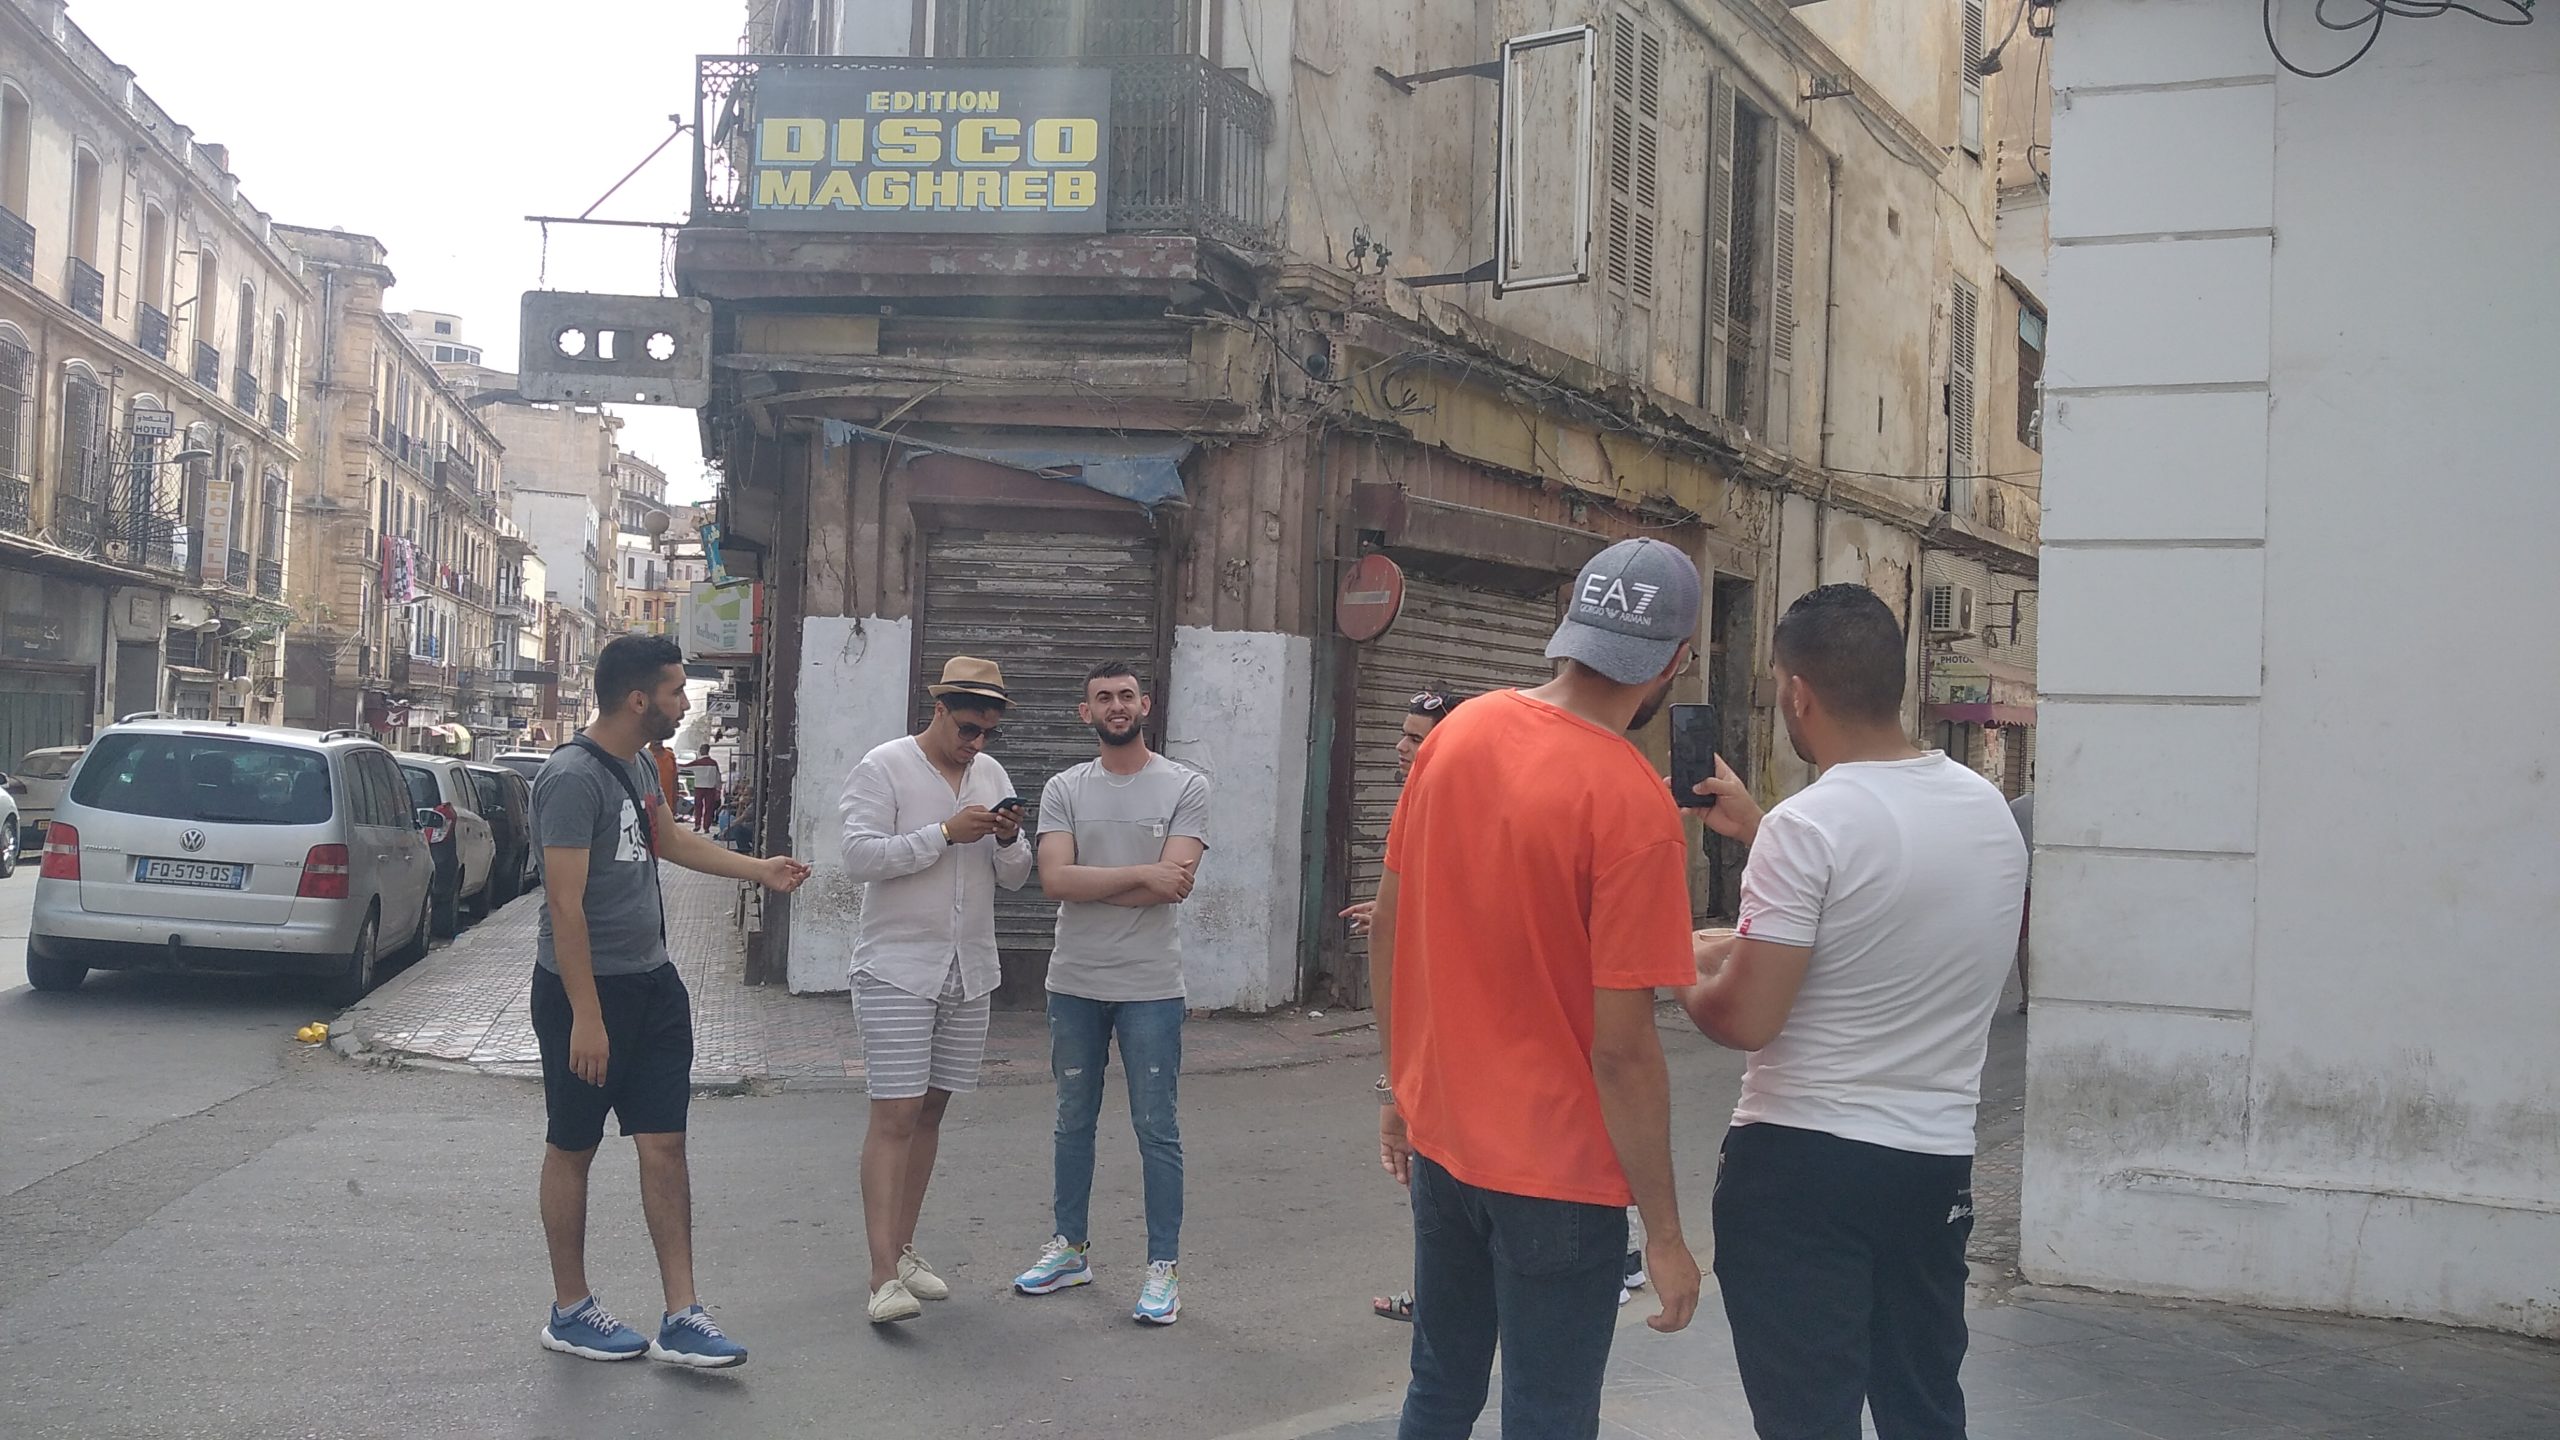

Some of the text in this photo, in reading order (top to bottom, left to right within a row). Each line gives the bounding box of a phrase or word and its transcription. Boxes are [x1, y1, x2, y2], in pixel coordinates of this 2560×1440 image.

[866, 91, 1000, 113] EDITION
[755, 118, 1098, 167] DISCO
[752, 170, 1097, 211] MAGHREB
[136, 425, 168, 435] HOTEL
[208, 492, 228, 563] HOTEL
[1580, 574, 1660, 614] EA7
[1619, 612, 1651, 625] ARMANI
